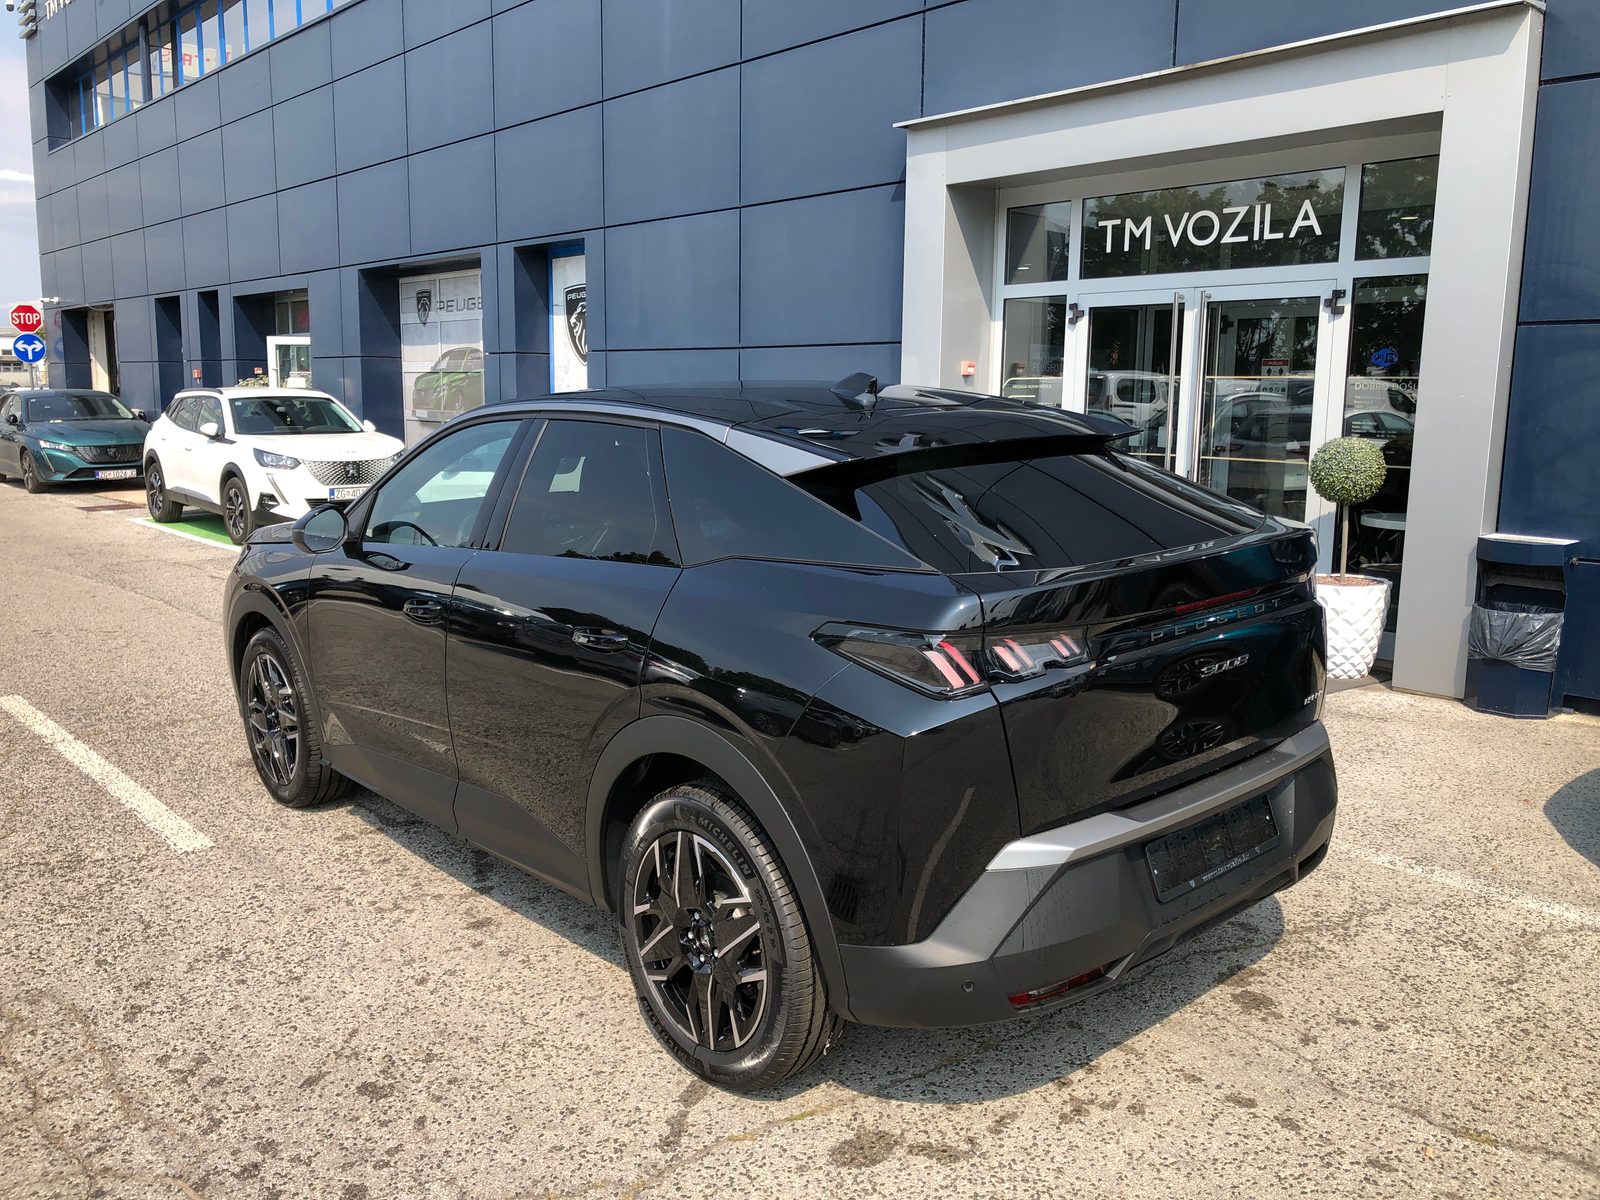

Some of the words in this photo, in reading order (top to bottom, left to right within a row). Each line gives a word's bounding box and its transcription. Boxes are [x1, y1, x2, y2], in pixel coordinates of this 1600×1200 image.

[1098, 216, 1152, 254] TM
[1163, 199, 1322, 248] VOZILA
[12, 312, 40, 325] STOP
[1354, 382, 1389, 391] DOBRO
[336, 490, 346, 498] ZG
[1151, 599, 1280, 641] PEUGEOT
[1200, 654, 1249, 677] 3008
[697, 816, 753, 876] MICHELIN
